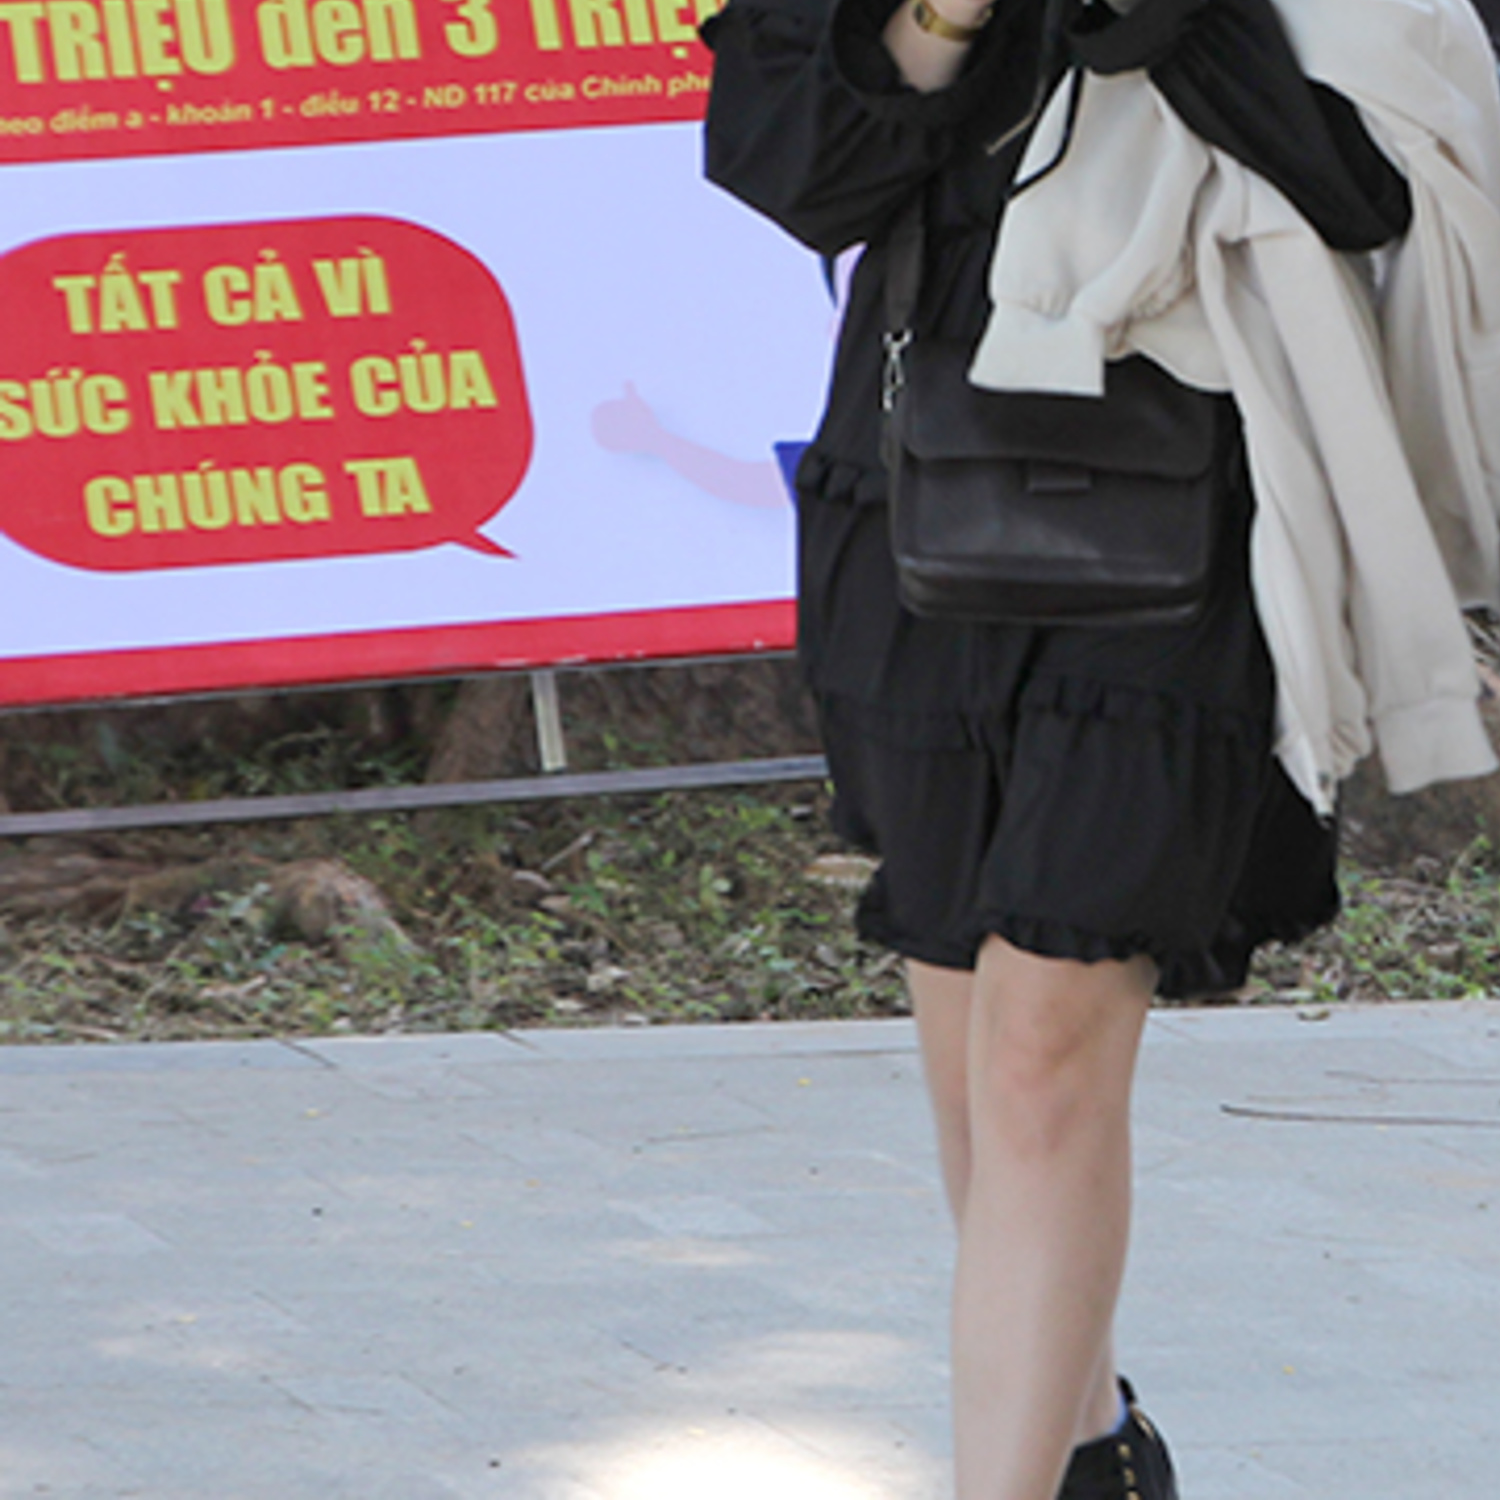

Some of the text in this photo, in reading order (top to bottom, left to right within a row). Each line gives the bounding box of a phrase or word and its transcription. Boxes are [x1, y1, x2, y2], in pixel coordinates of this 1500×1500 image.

[260, 97, 274, 119] 1
[368, 90, 398, 112] 12
[474, 80, 518, 106] 117
[53, 248, 391, 333] TẤT CẢ VÌ
[0, 340, 497, 439] SỨC KHỎE CỦA
[85, 457, 431, 536] CHÚNG TA
